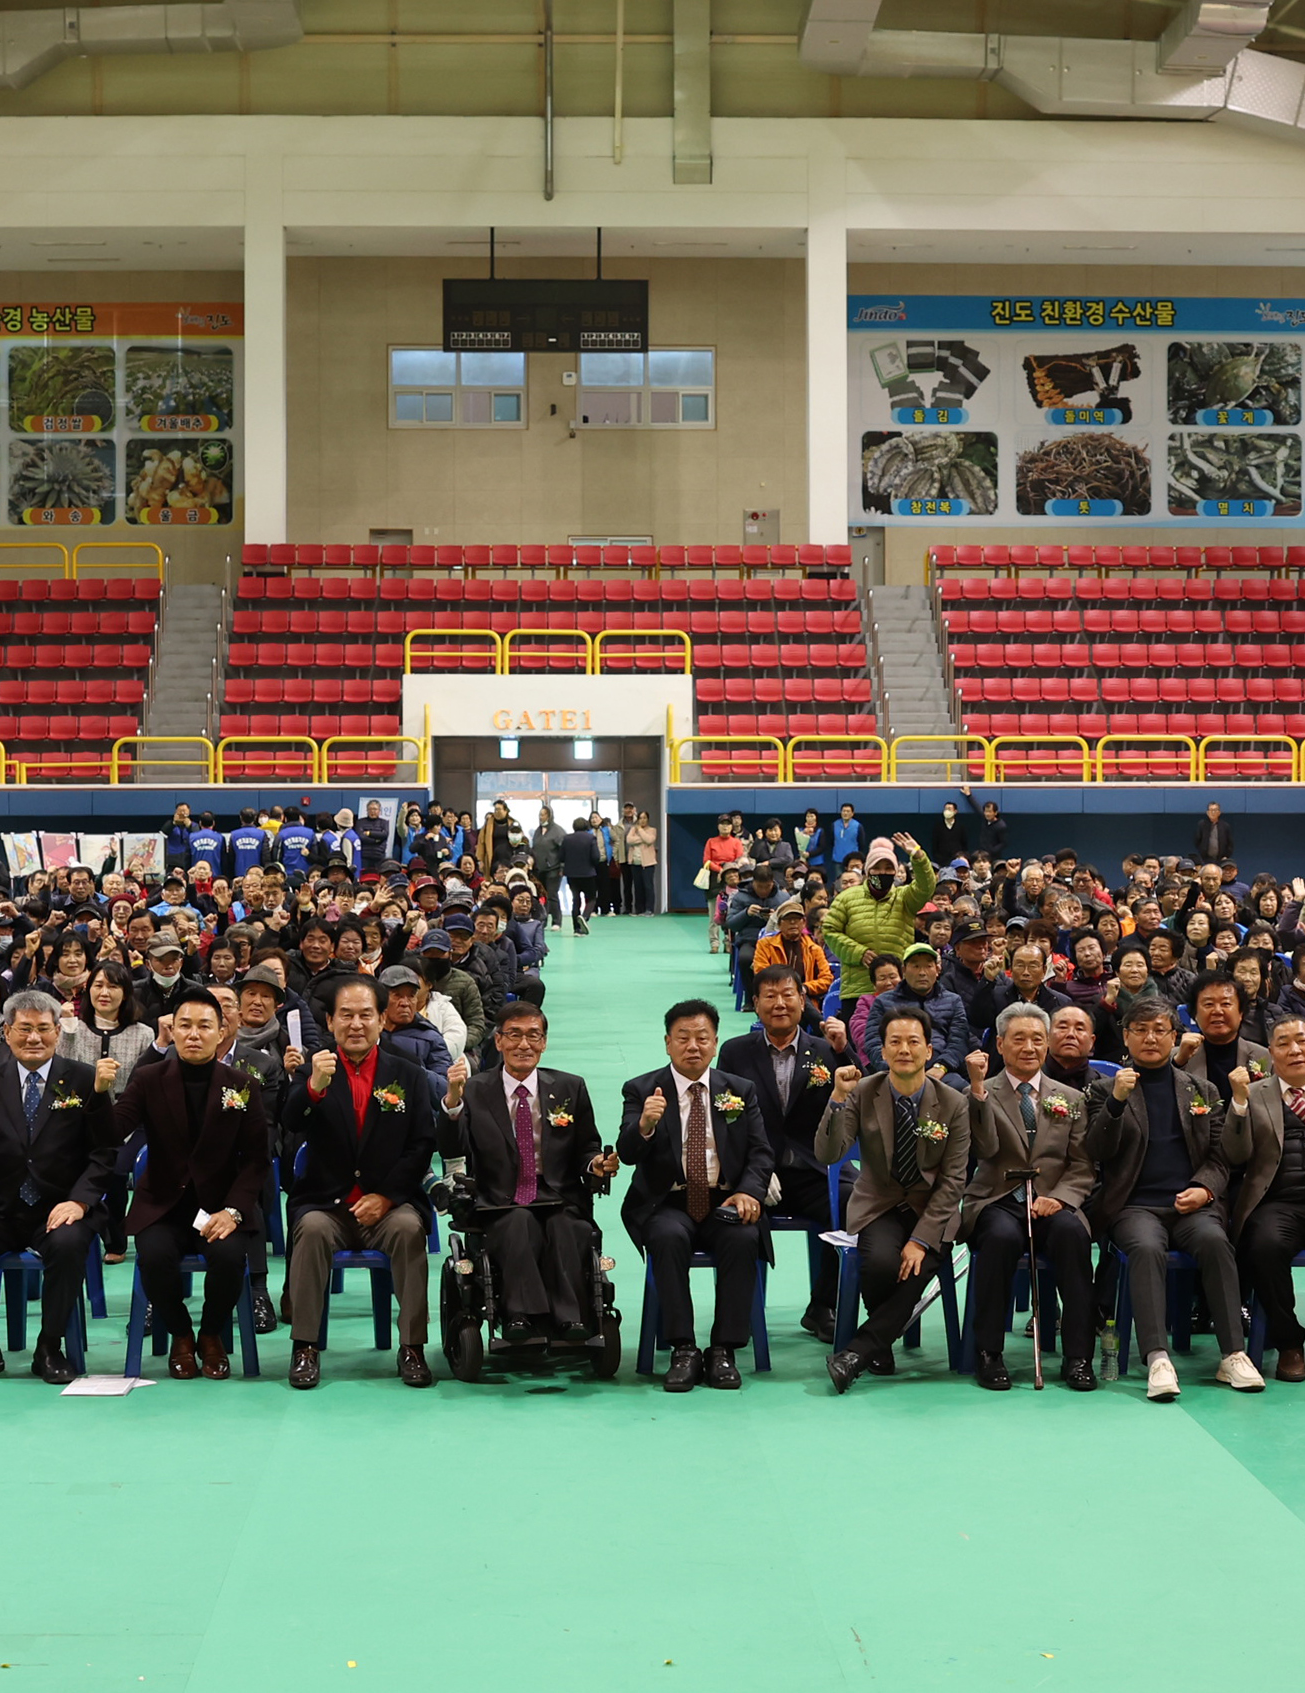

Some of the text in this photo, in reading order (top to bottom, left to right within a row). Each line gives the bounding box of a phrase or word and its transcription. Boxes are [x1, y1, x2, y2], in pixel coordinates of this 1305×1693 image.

[29, 306, 95, 332] 농산물
[853, 307, 898, 322] Jindo
[991, 300, 1176, 326] 진도 친환경 수산물
[43, 417, 83, 430] 검정쌀
[156, 417, 203, 430] 겨울배추
[1064, 411, 1105, 424] 돌미역
[910, 501, 951, 514] 참전복
[1078, 501, 1090, 515] 톳
[493, 709, 592, 730] GATE1
